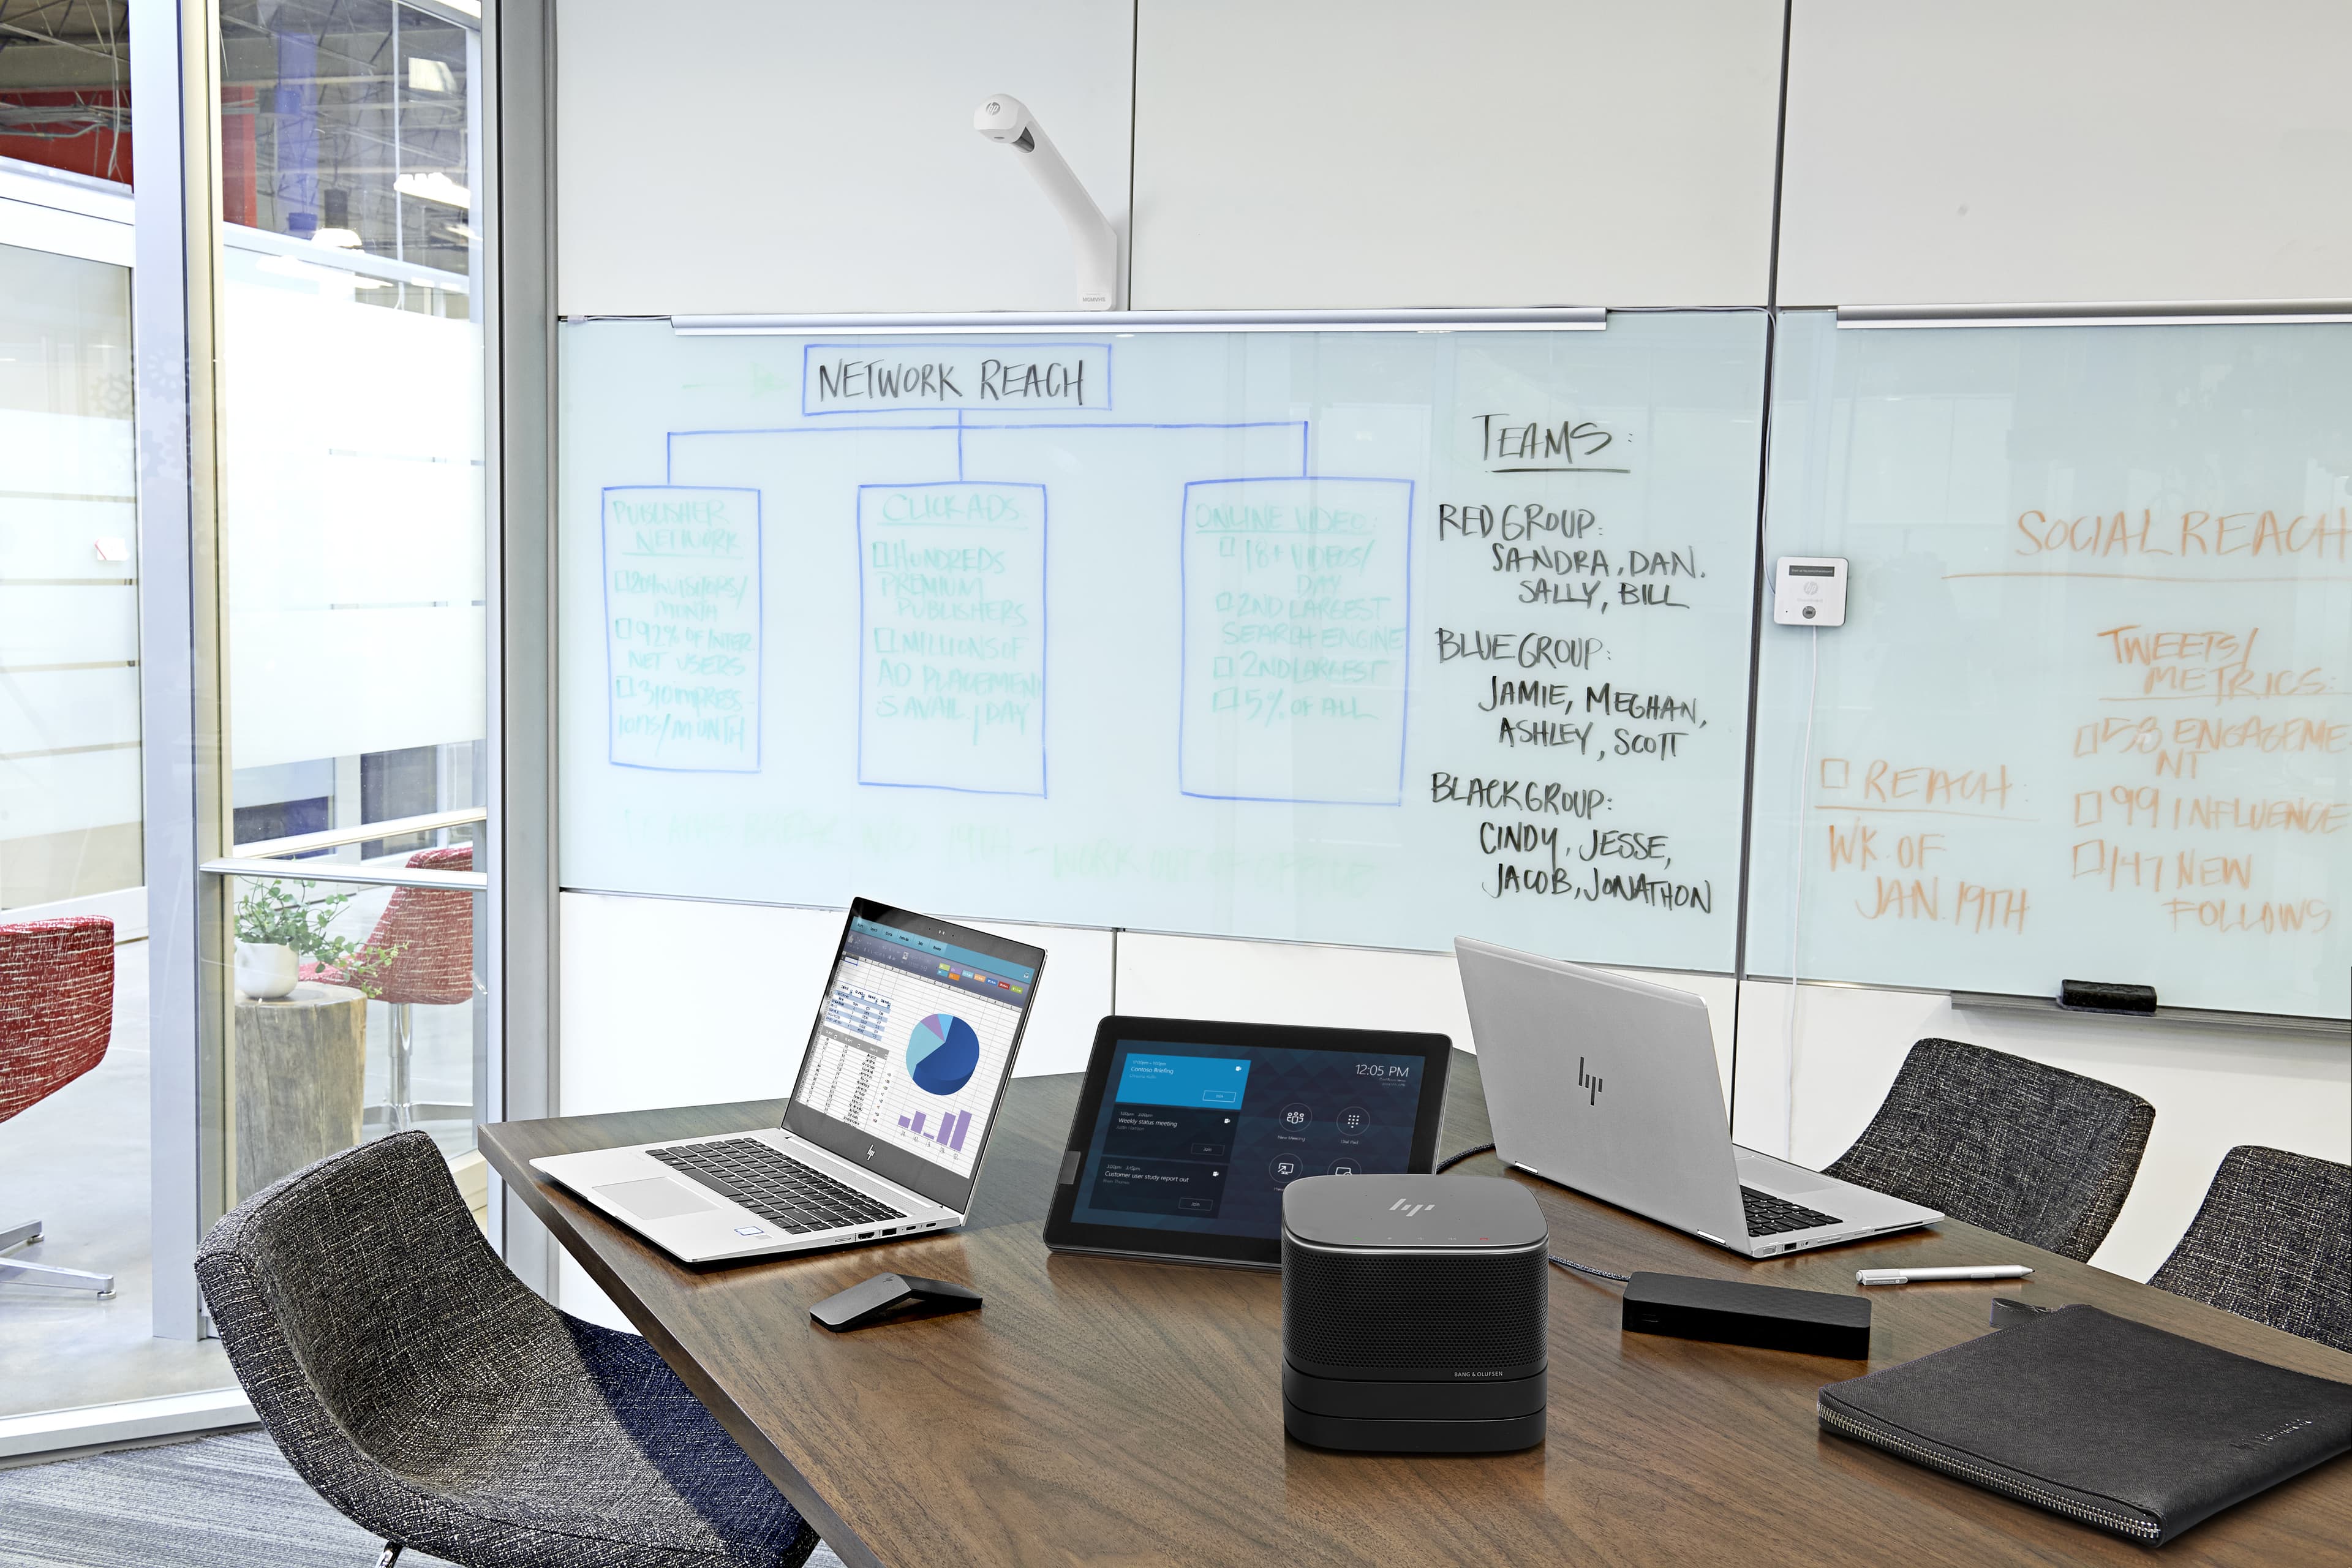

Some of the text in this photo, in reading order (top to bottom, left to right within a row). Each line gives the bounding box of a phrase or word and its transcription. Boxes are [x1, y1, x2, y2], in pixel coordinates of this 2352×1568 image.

[820, 359, 1083, 405] NETWORK REACH
[1196, 503, 1283, 530] ONLINE
[2015, 507, 2352, 563] SOCIAL REACH
[894, 539, 1005, 574] HUNDREDS
[1491, 542, 1624, 576] SANDRA,
[1518, 578, 1690, 614] SALLY, BILL
[1434, 627, 1517, 664] BLUE
[1478, 676, 1708, 729] JAMIE, MEGHAN,
[1499, 717, 1689, 761] ASHLEY, SCOTT
[1430, 771, 1523, 811] BLACK
[2110, 785, 2160, 829] 99
[1479, 821, 1672, 873] CINDY, JESSE,
[1898, 834, 1947, 870] OF
[1482, 862, 1712, 914] JACOB, JONATHON
[2176, 848, 2253, 890] NEW
[1954, 881, 2030, 935] 19TH
[2161, 897, 2332, 935] FOLLOWS
[1355, 1064, 1409, 1077] 12:05 PM
